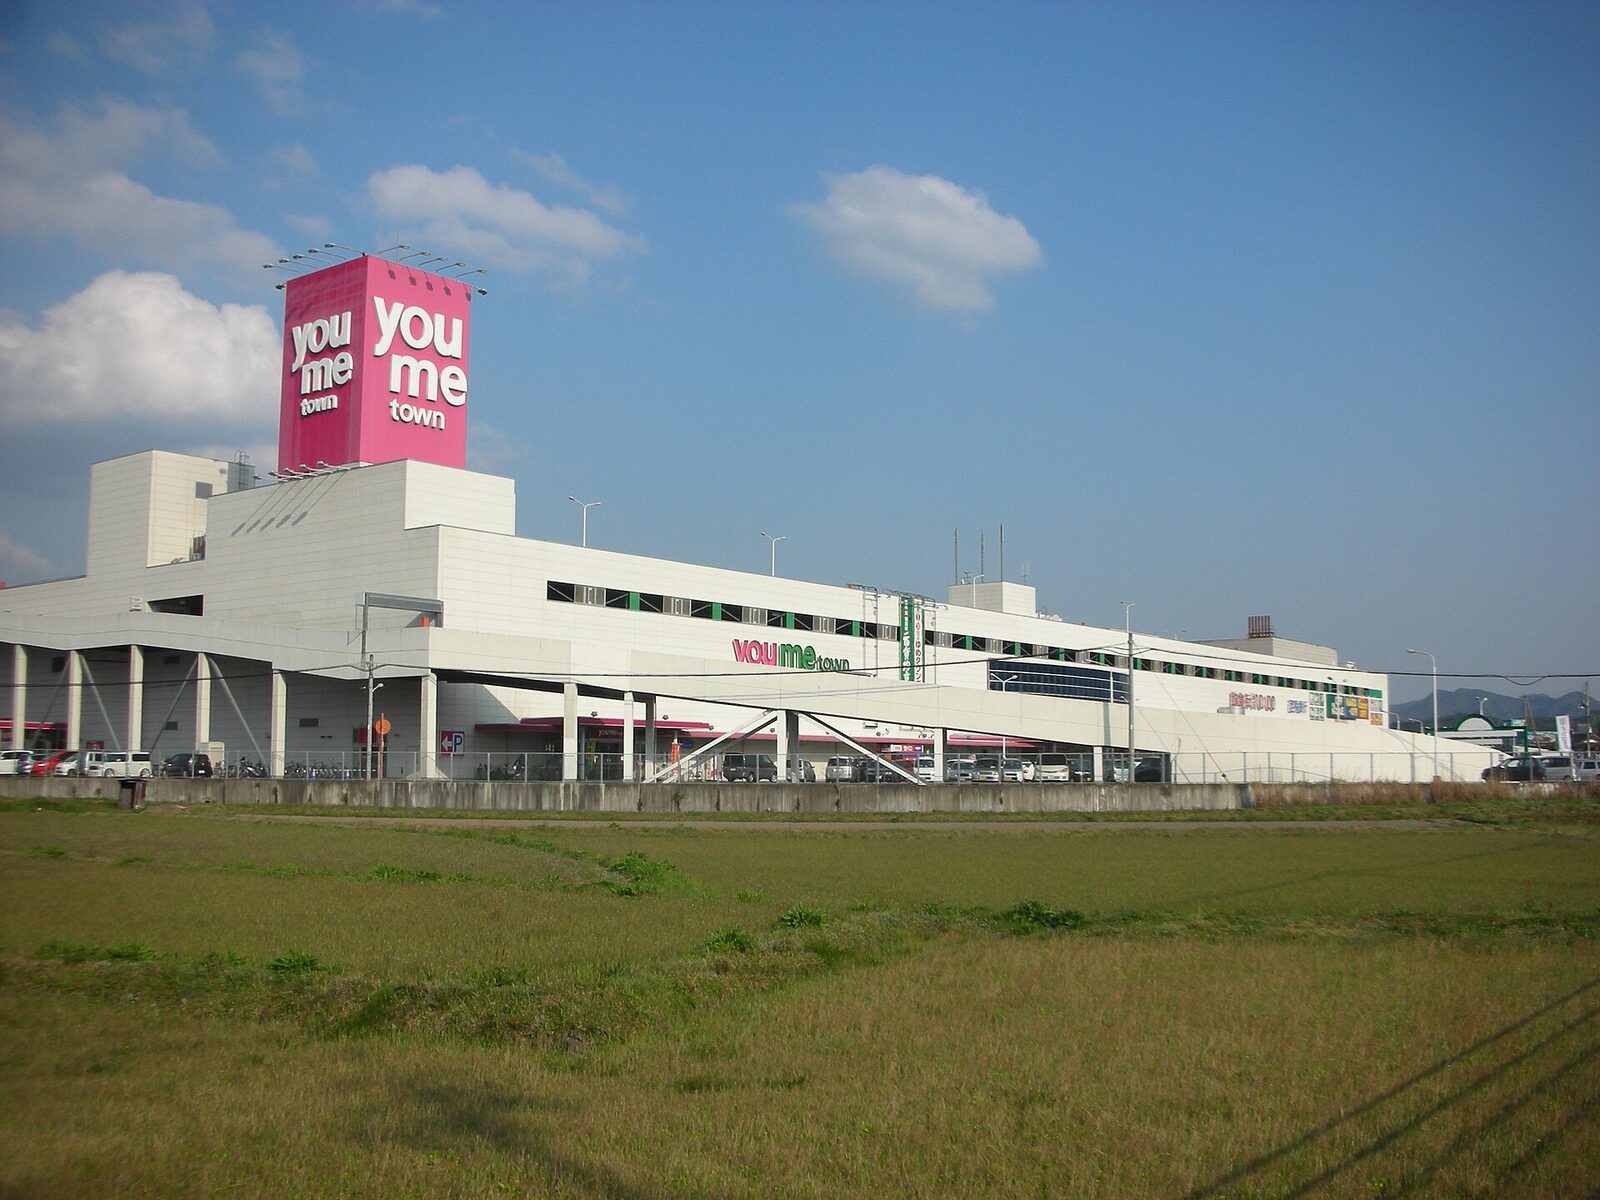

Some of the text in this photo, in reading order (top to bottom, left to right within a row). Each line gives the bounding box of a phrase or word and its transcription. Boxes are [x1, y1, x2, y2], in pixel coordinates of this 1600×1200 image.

[291, 311, 352, 372] you
[373, 296, 464, 358] you
[301, 351, 353, 395] me
[389, 353, 468, 407] me
[301, 393, 338, 416] town
[389, 399, 446, 430] town
[816, 655, 850, 671] town
[454, 735, 463, 753] P
